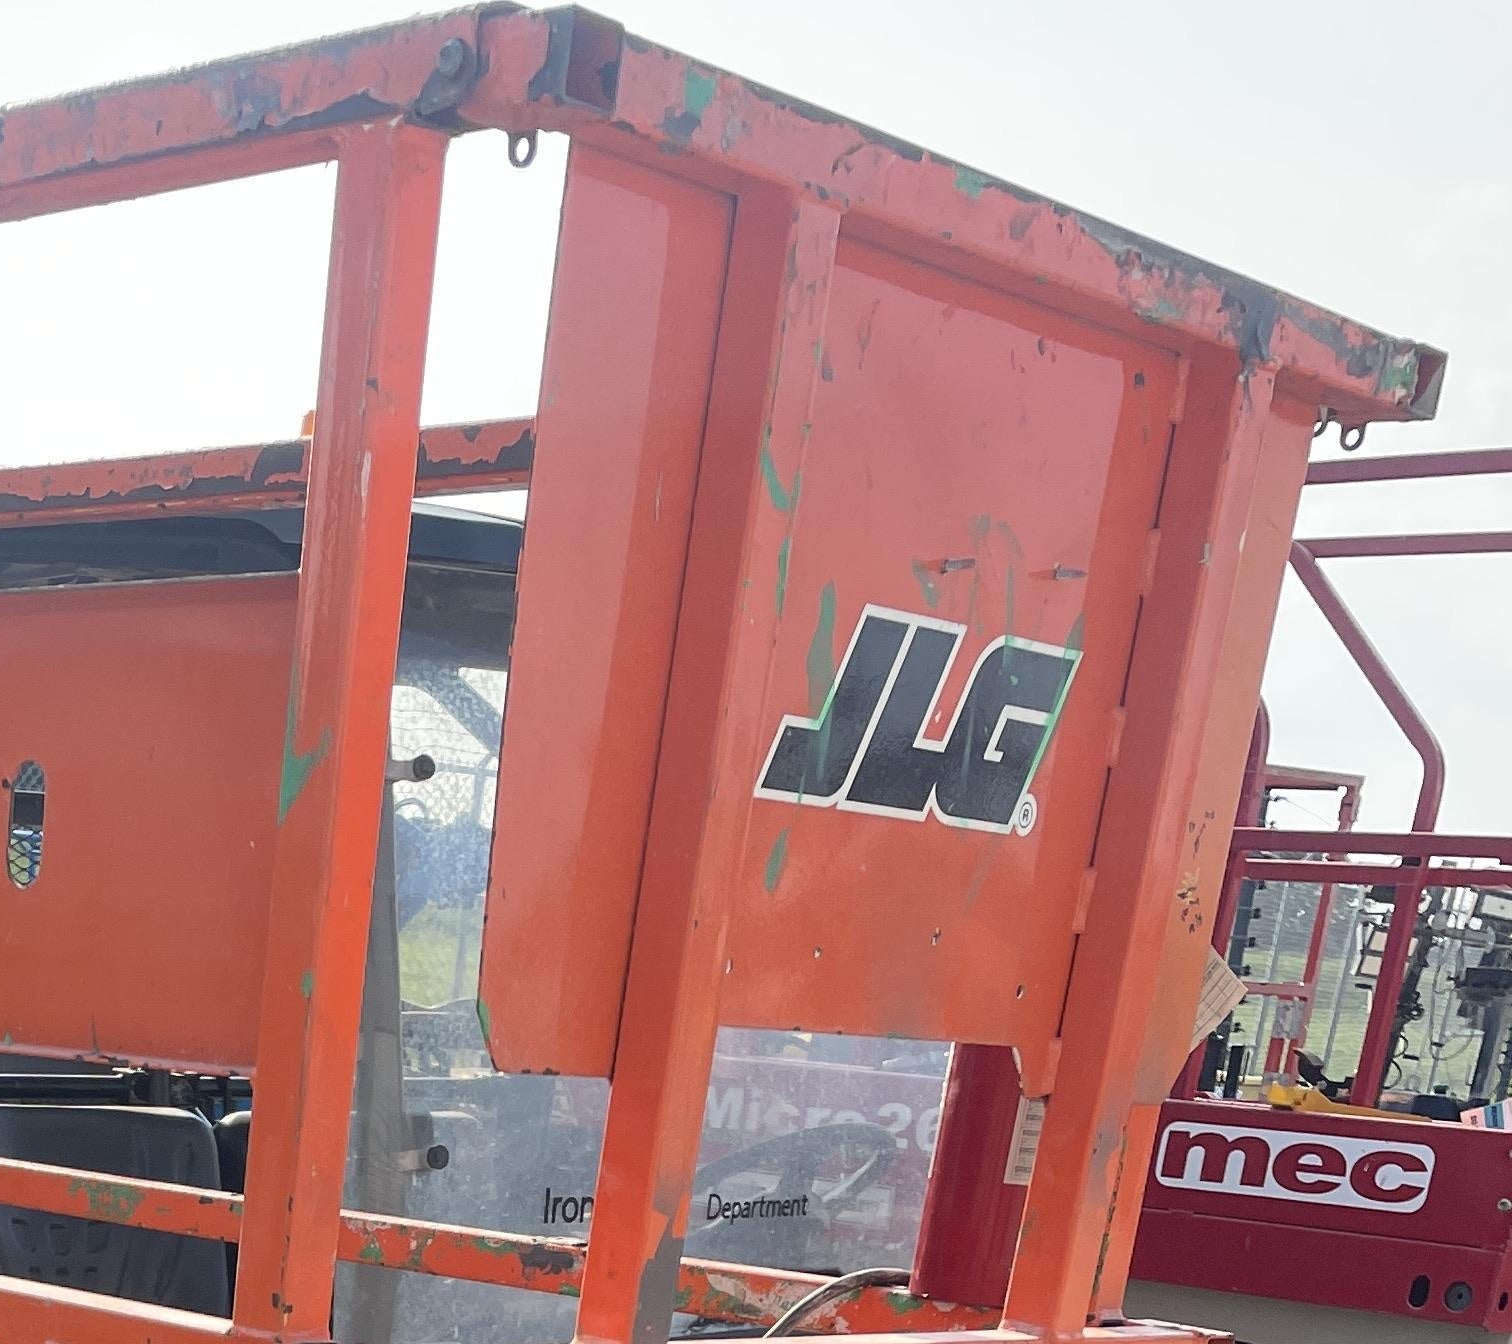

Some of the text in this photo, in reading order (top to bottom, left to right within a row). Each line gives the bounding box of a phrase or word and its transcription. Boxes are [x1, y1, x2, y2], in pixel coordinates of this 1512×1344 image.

[754, 603, 1084, 836] JLG
[1160, 1130, 1428, 1203] mec
[707, 1193, 809, 1224] Department
